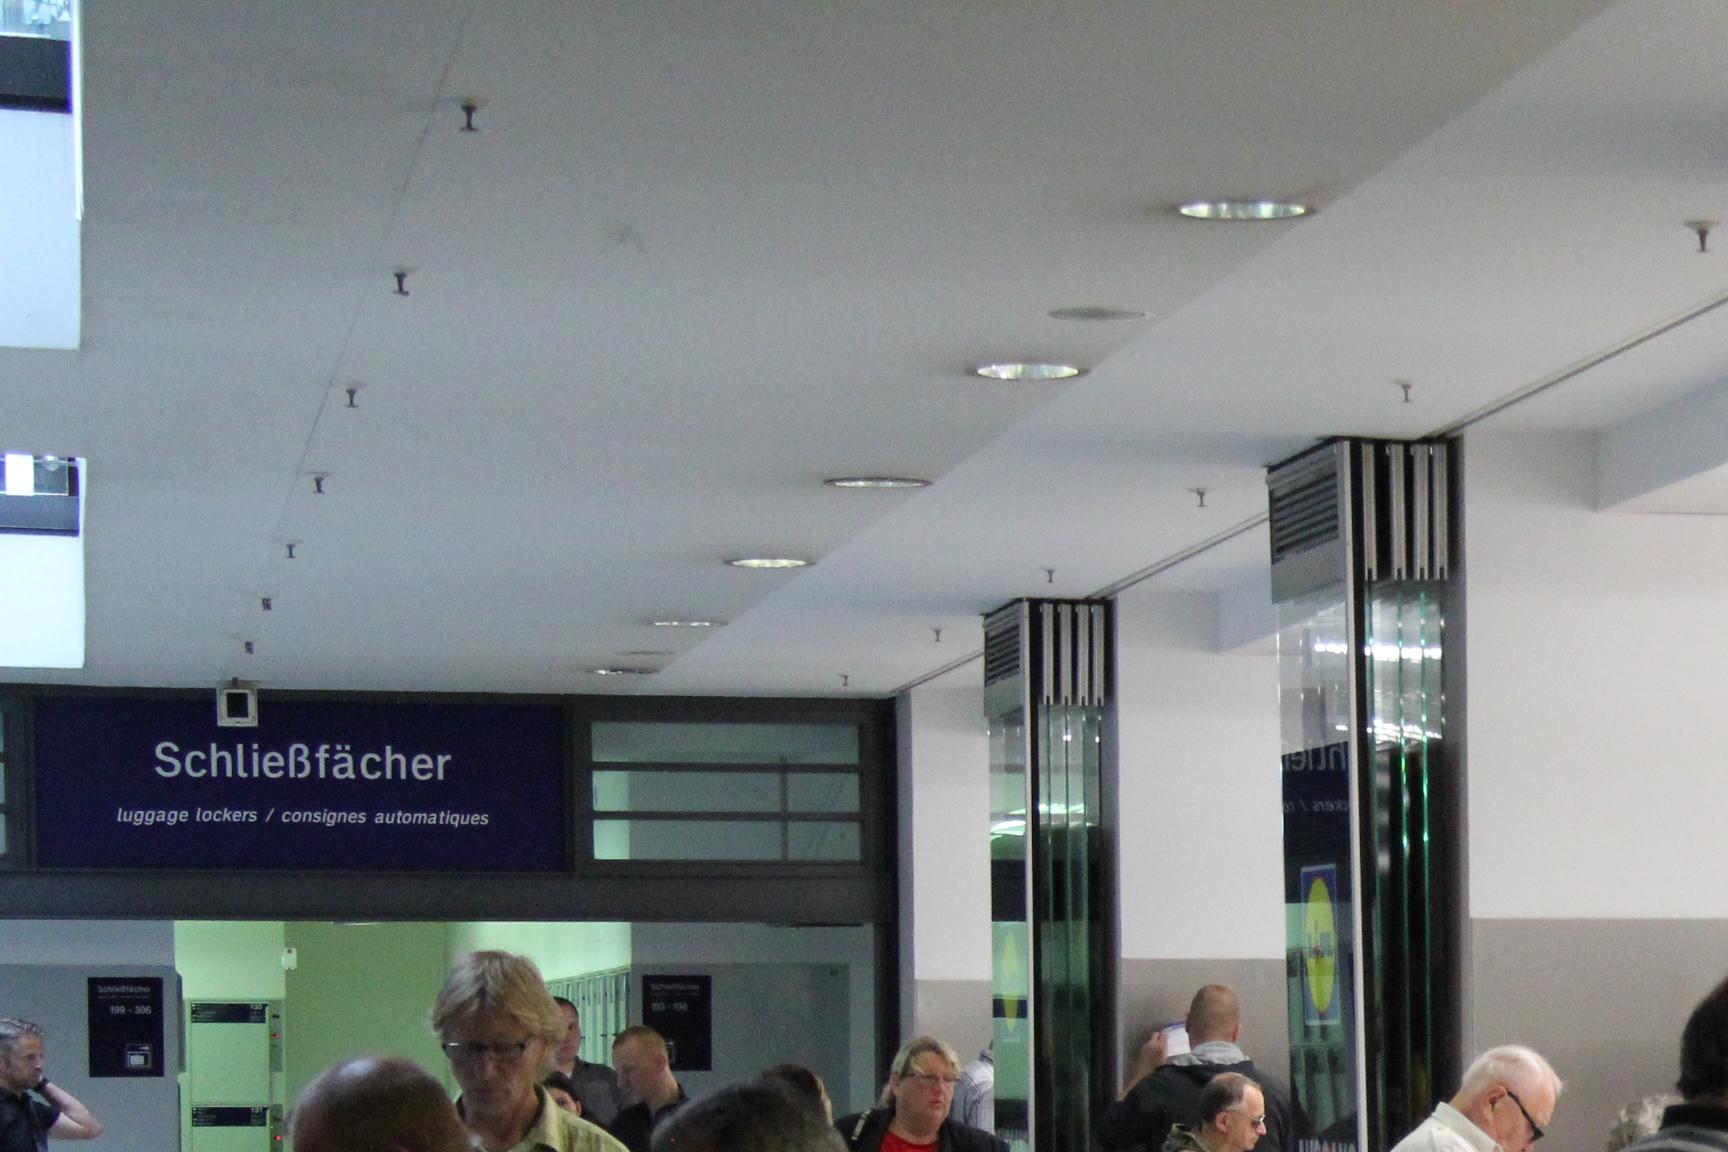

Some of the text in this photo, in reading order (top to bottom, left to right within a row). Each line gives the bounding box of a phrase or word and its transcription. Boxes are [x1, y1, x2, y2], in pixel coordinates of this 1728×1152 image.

[155, 741, 452, 781] Schließfächer
[116, 807, 490, 828] luggage lockers / consignes automatiques
